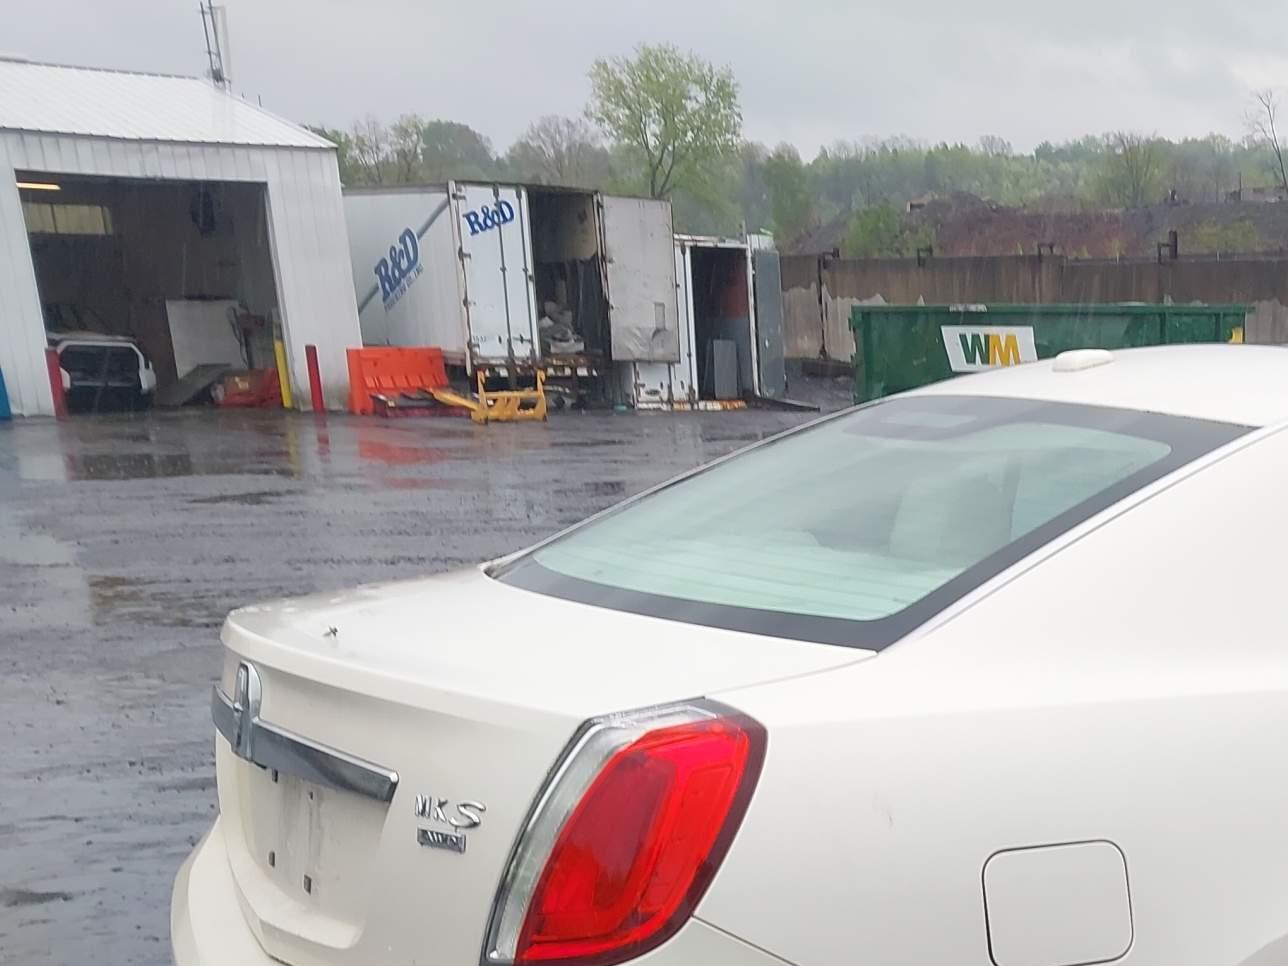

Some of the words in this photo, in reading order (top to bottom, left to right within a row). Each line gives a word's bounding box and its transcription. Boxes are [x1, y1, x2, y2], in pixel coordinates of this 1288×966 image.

[463, 200, 515, 236] R&D
[374, 229, 419, 302] R&D
[958, 333, 1021, 367] WM
[414, 793, 486, 829] MKS
